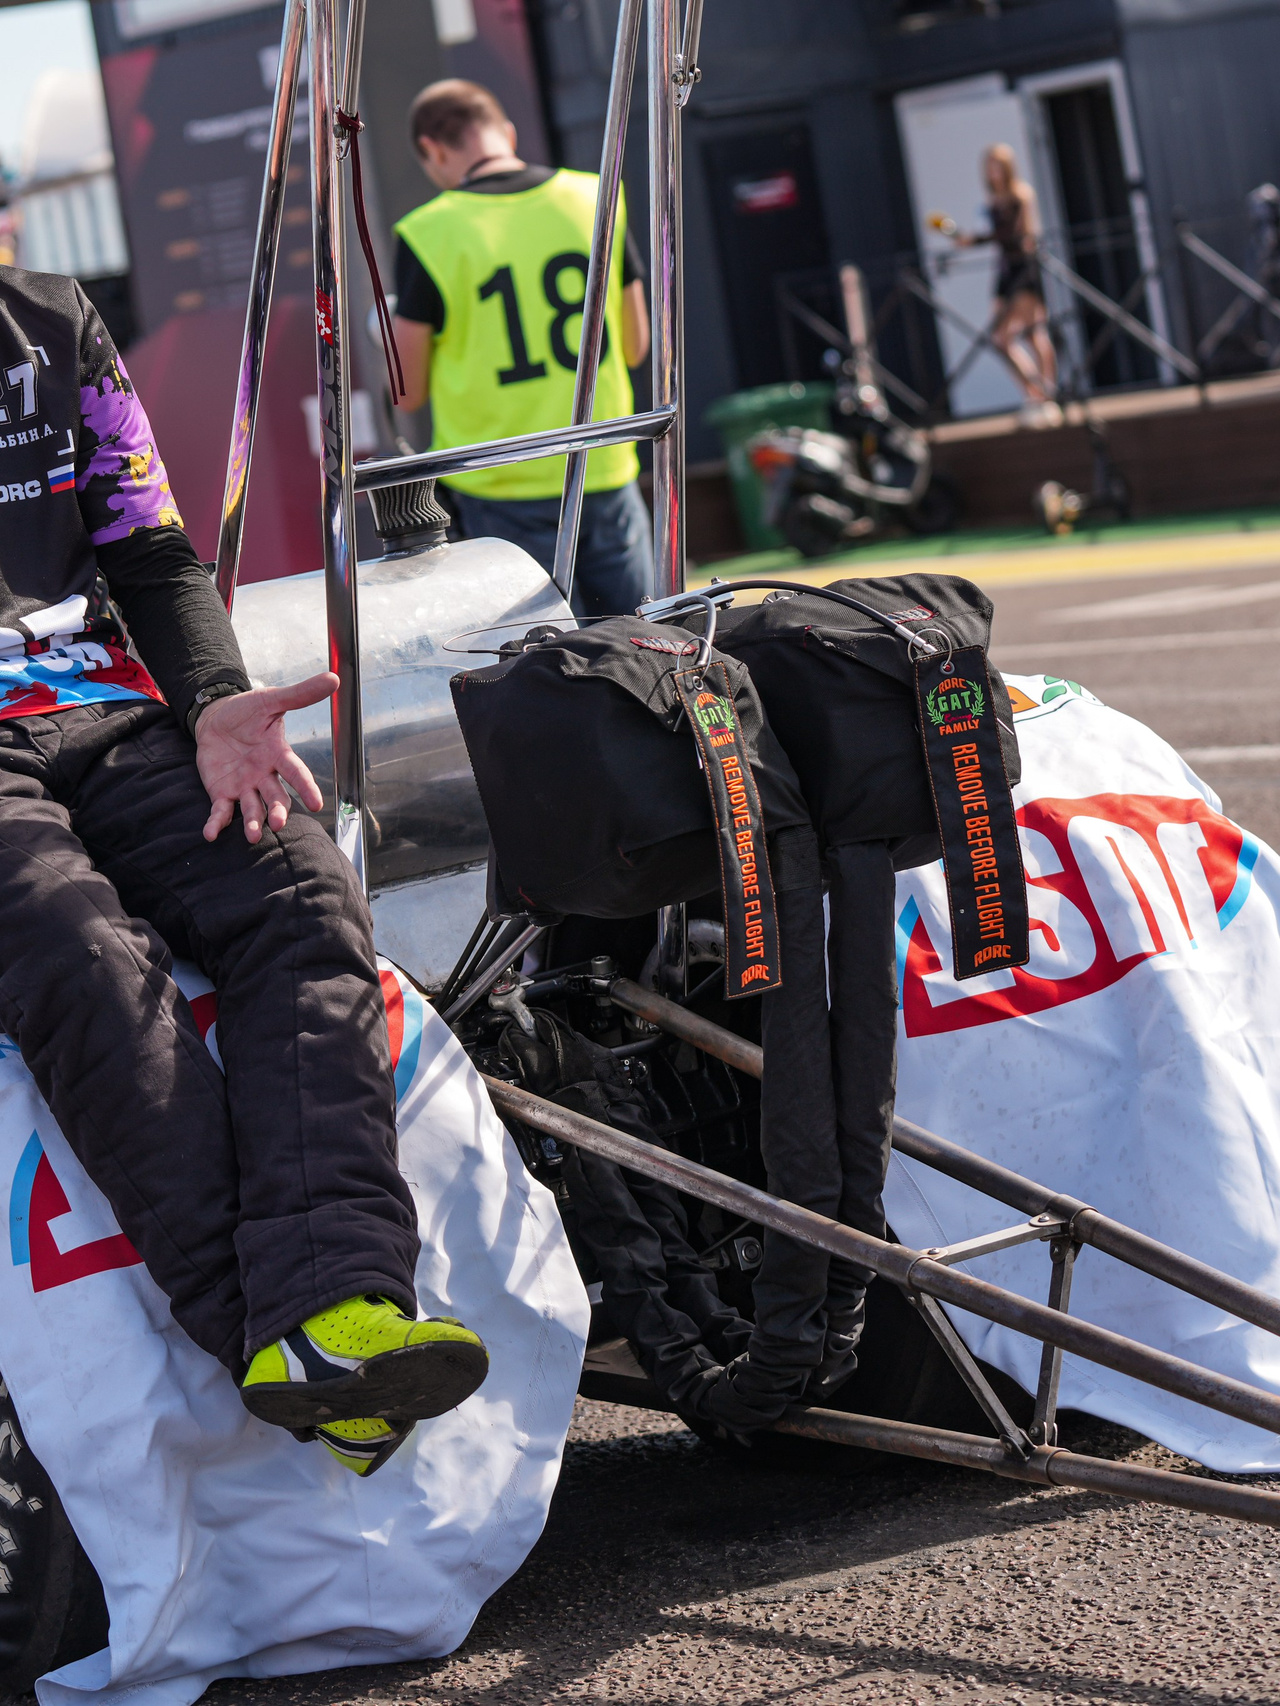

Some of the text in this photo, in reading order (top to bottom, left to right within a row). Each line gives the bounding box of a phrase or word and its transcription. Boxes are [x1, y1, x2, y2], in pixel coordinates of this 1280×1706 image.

[478, 251, 609, 386] 18
[938, 677, 967, 695] RDRC
[937, 691, 971, 712] GAT
[700, 705, 725, 726] GAT
[939, 719, 980, 736] FAMILY
[709, 732, 735, 748] FAMILY
[951, 742, 1005, 940] REMOVE BEFORE FLIGHT
[721, 755, 764, 959] REMOVE BEFORE FLIGHT
[974, 944, 1012, 968] RDRC
[741, 964, 770, 988] RDRC
